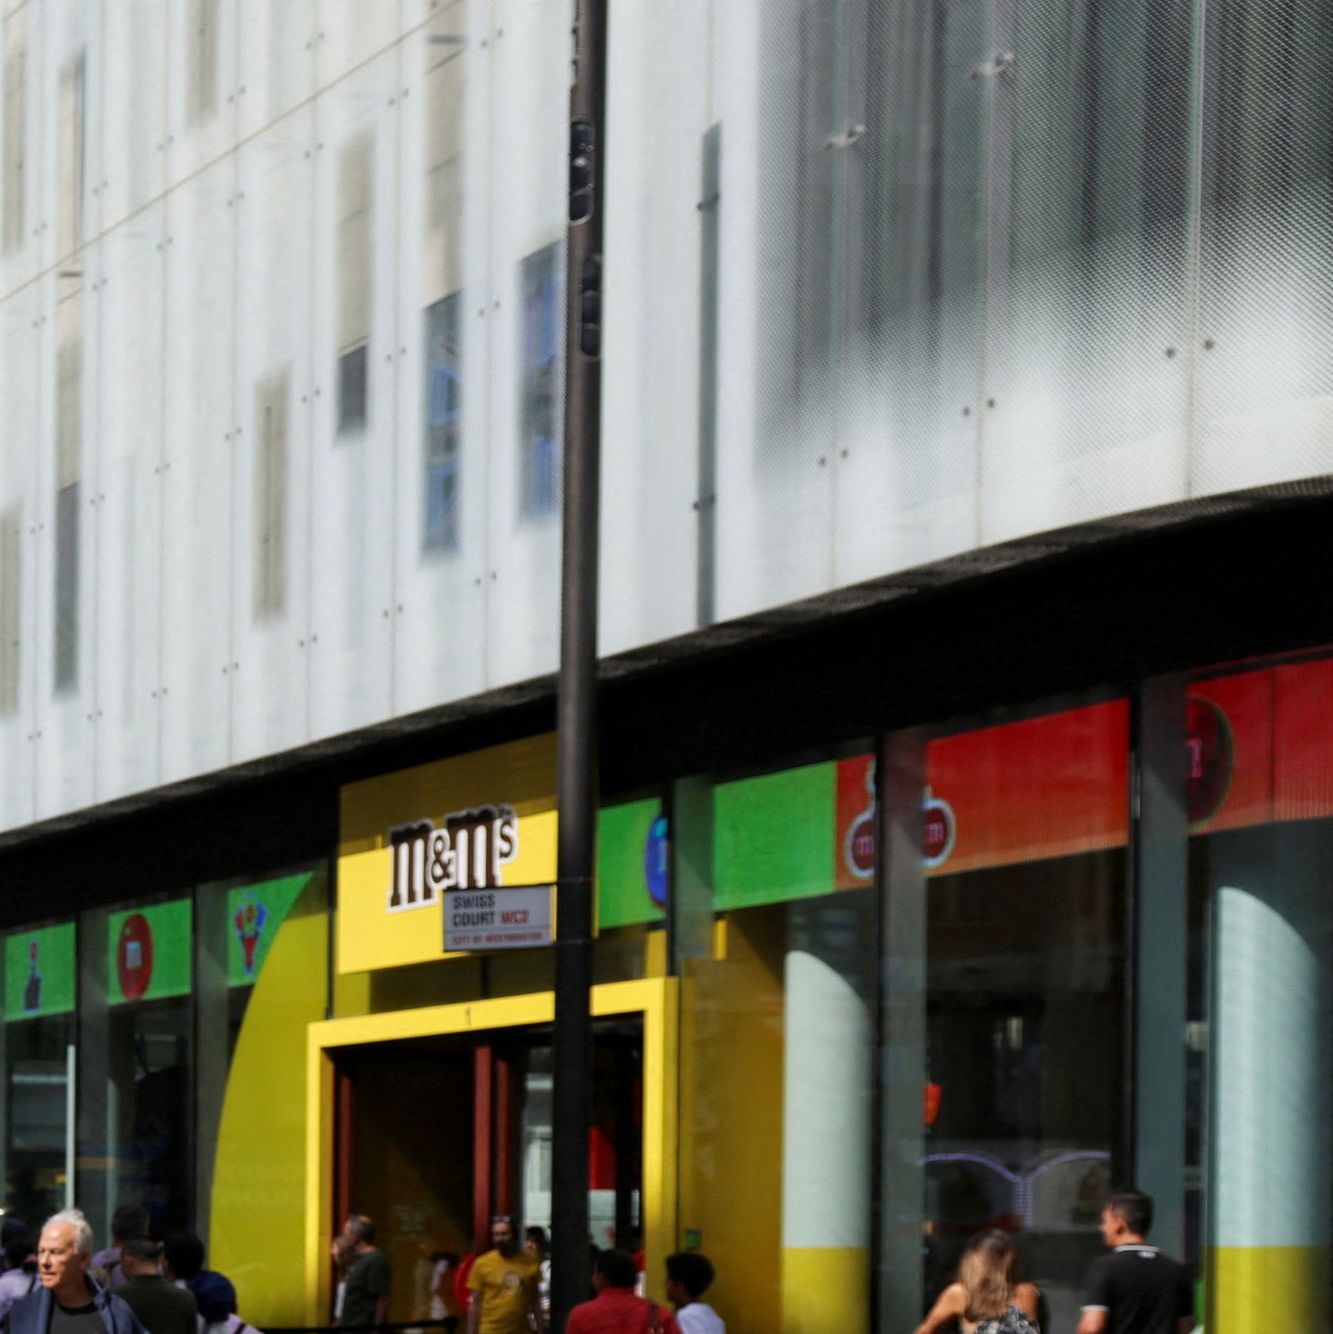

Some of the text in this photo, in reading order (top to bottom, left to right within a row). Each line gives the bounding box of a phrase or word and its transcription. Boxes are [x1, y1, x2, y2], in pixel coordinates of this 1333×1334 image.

[453, 893, 495, 910] SWISS
[453, 909, 530, 928] COURT WC2
